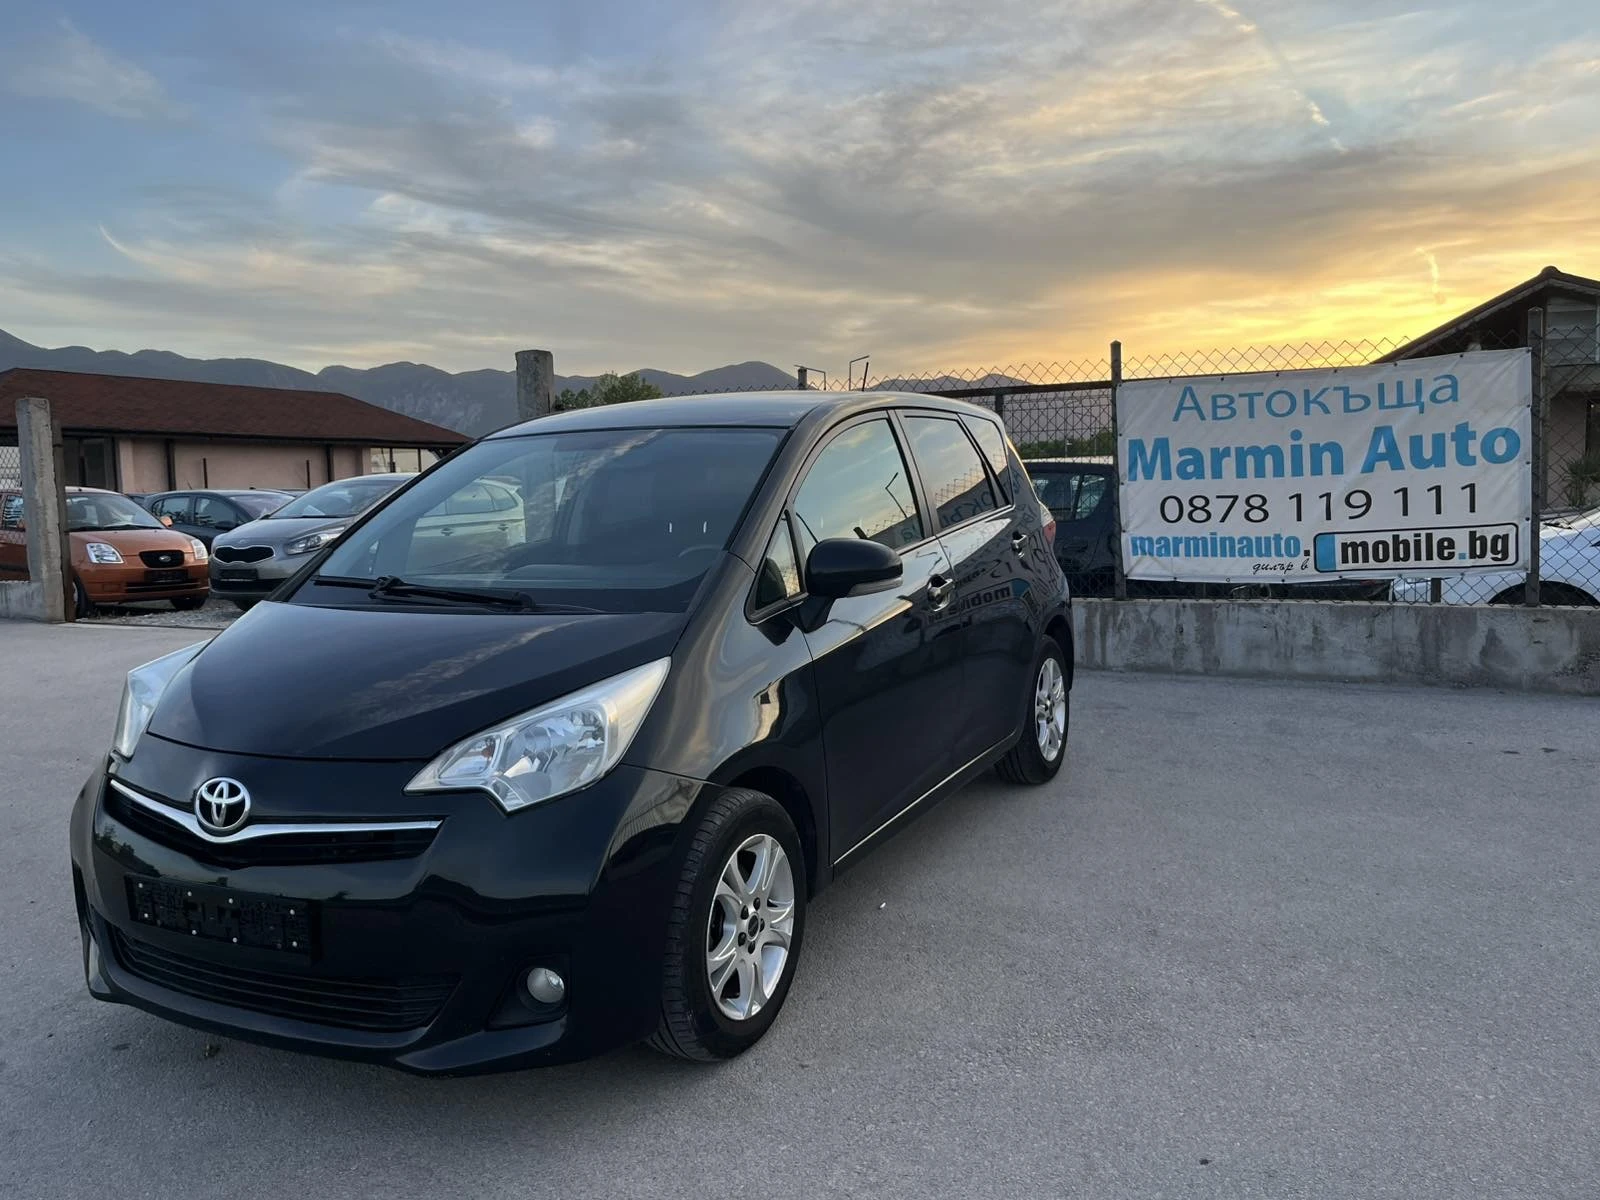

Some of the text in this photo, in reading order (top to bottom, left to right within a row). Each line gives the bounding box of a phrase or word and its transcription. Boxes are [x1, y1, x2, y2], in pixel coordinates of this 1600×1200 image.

[1172, 374, 1459, 422] Автокъща
[1127, 421, 1521, 481] Marmin Auto
[1160, 483, 1476, 523] 0878 119 111
[1340, 530, 1509, 564] mobile.bg
